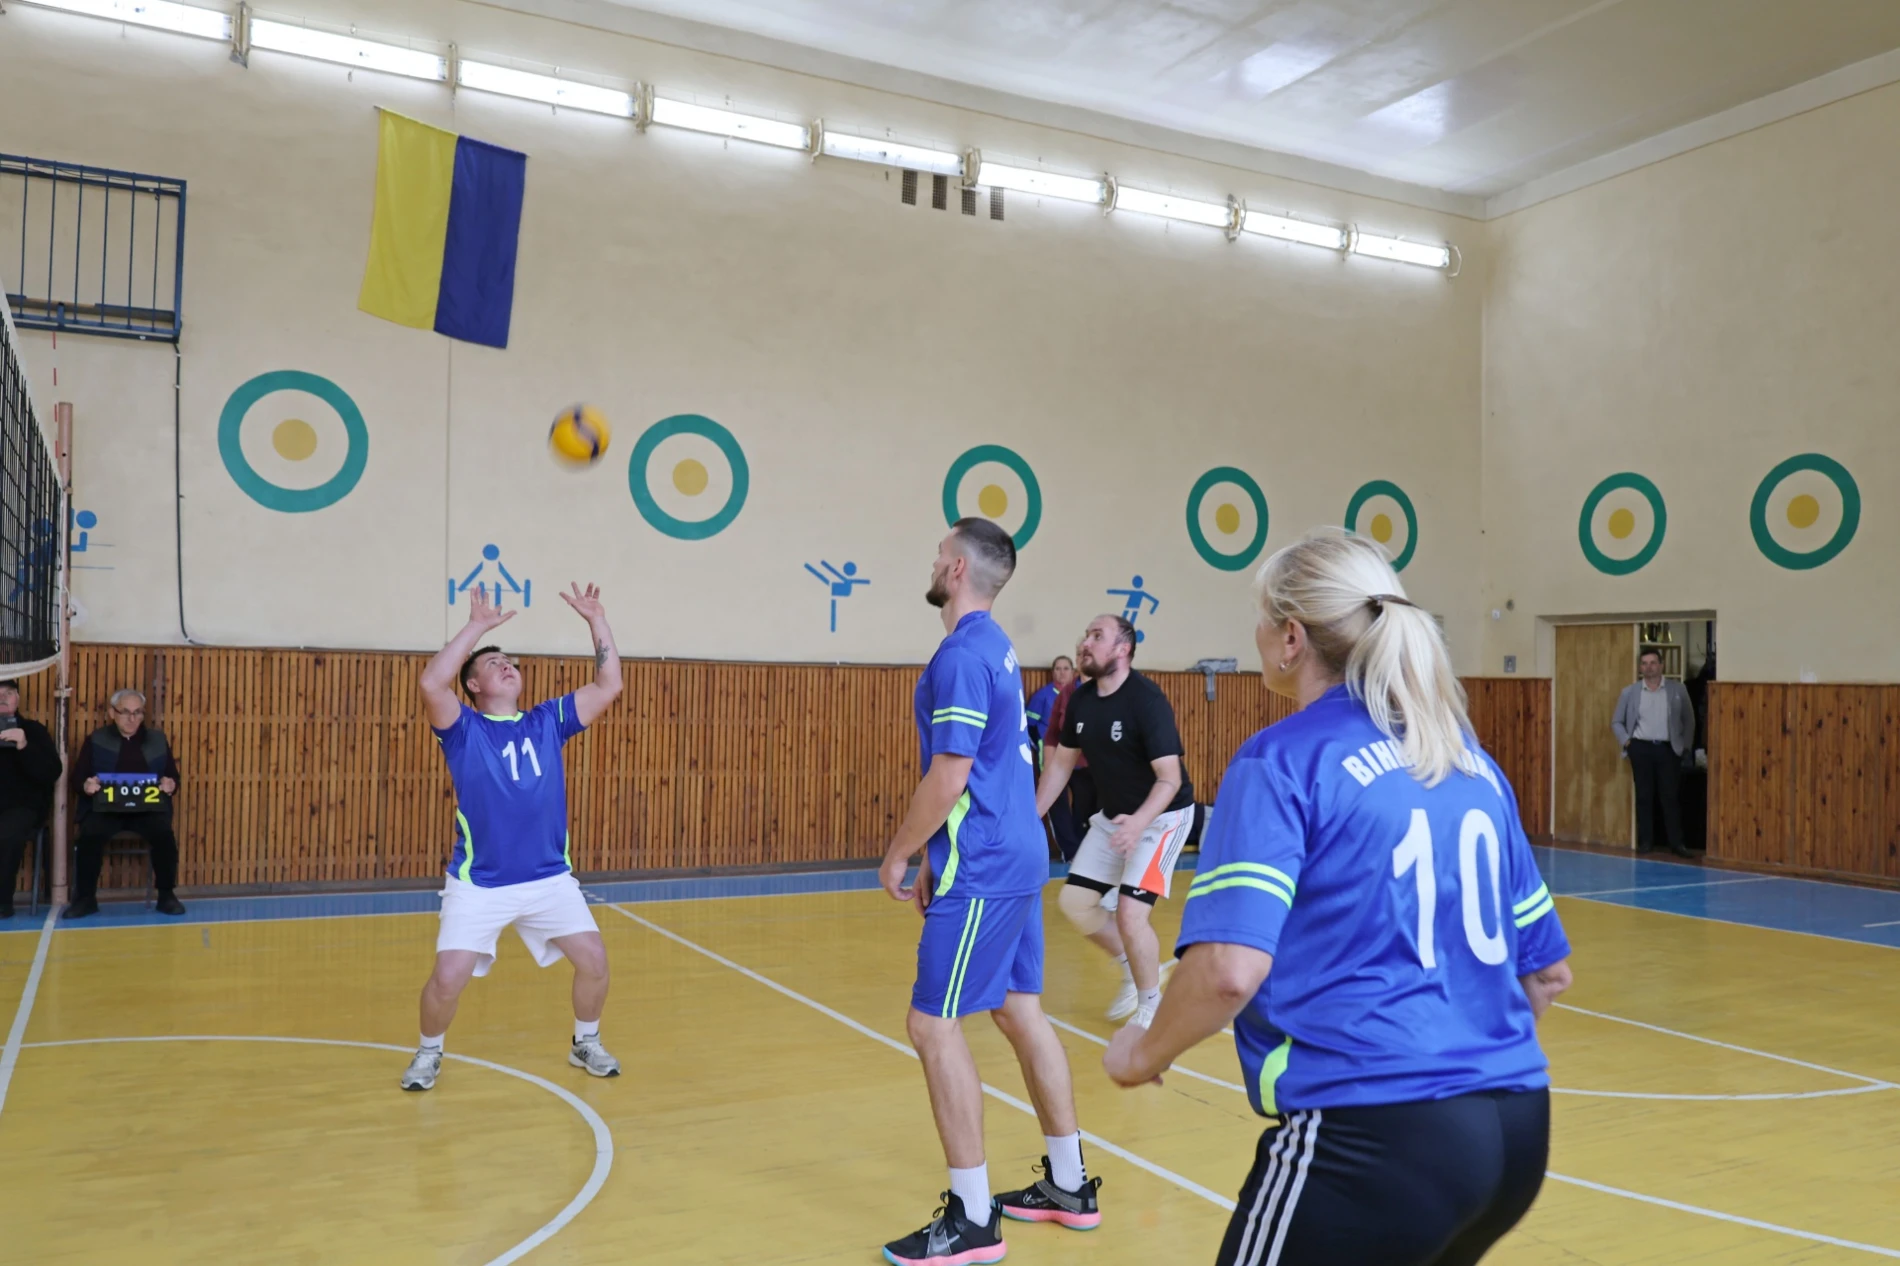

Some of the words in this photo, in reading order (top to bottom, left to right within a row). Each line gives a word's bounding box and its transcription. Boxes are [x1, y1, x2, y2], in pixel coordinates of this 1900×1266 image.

[502, 737, 542, 781] 11
[103, 786, 114, 803] 1
[144, 786, 160, 803] 2
[1392, 808, 1509, 969] 10
